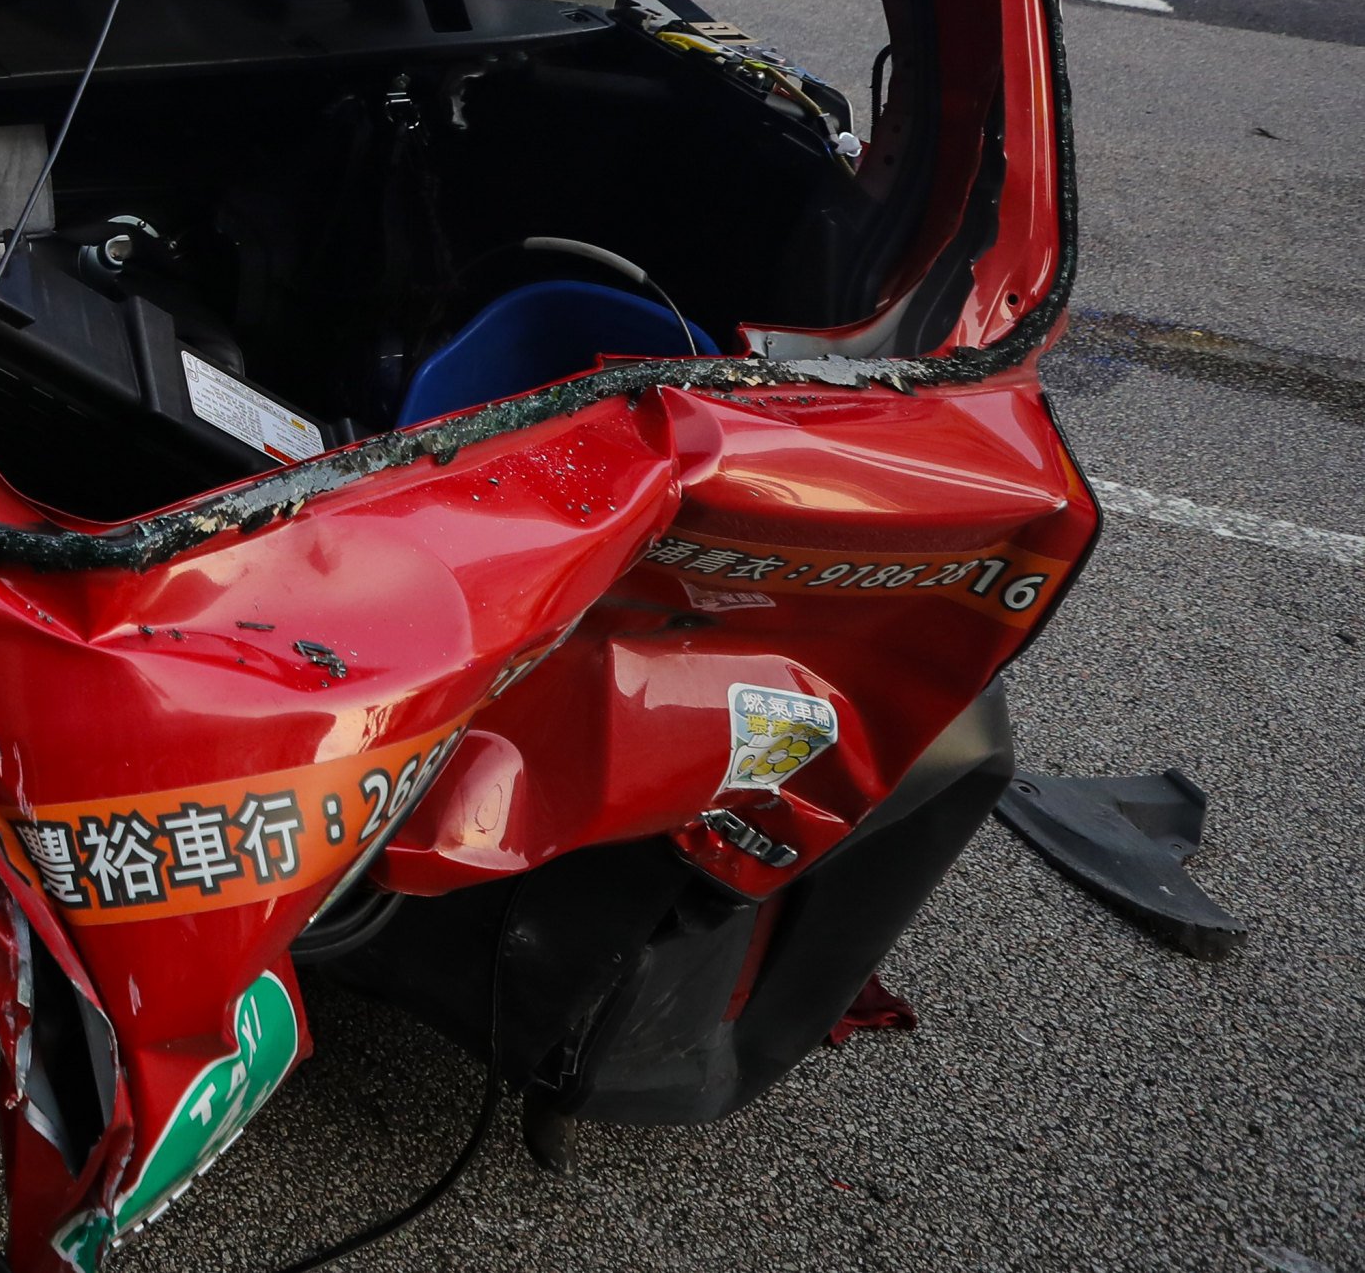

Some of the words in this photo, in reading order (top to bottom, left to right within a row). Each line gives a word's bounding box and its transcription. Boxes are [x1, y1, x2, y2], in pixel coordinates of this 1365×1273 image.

[809, 561, 926, 590] 9186
[741, 691, 831, 728] 燃氣車輛
